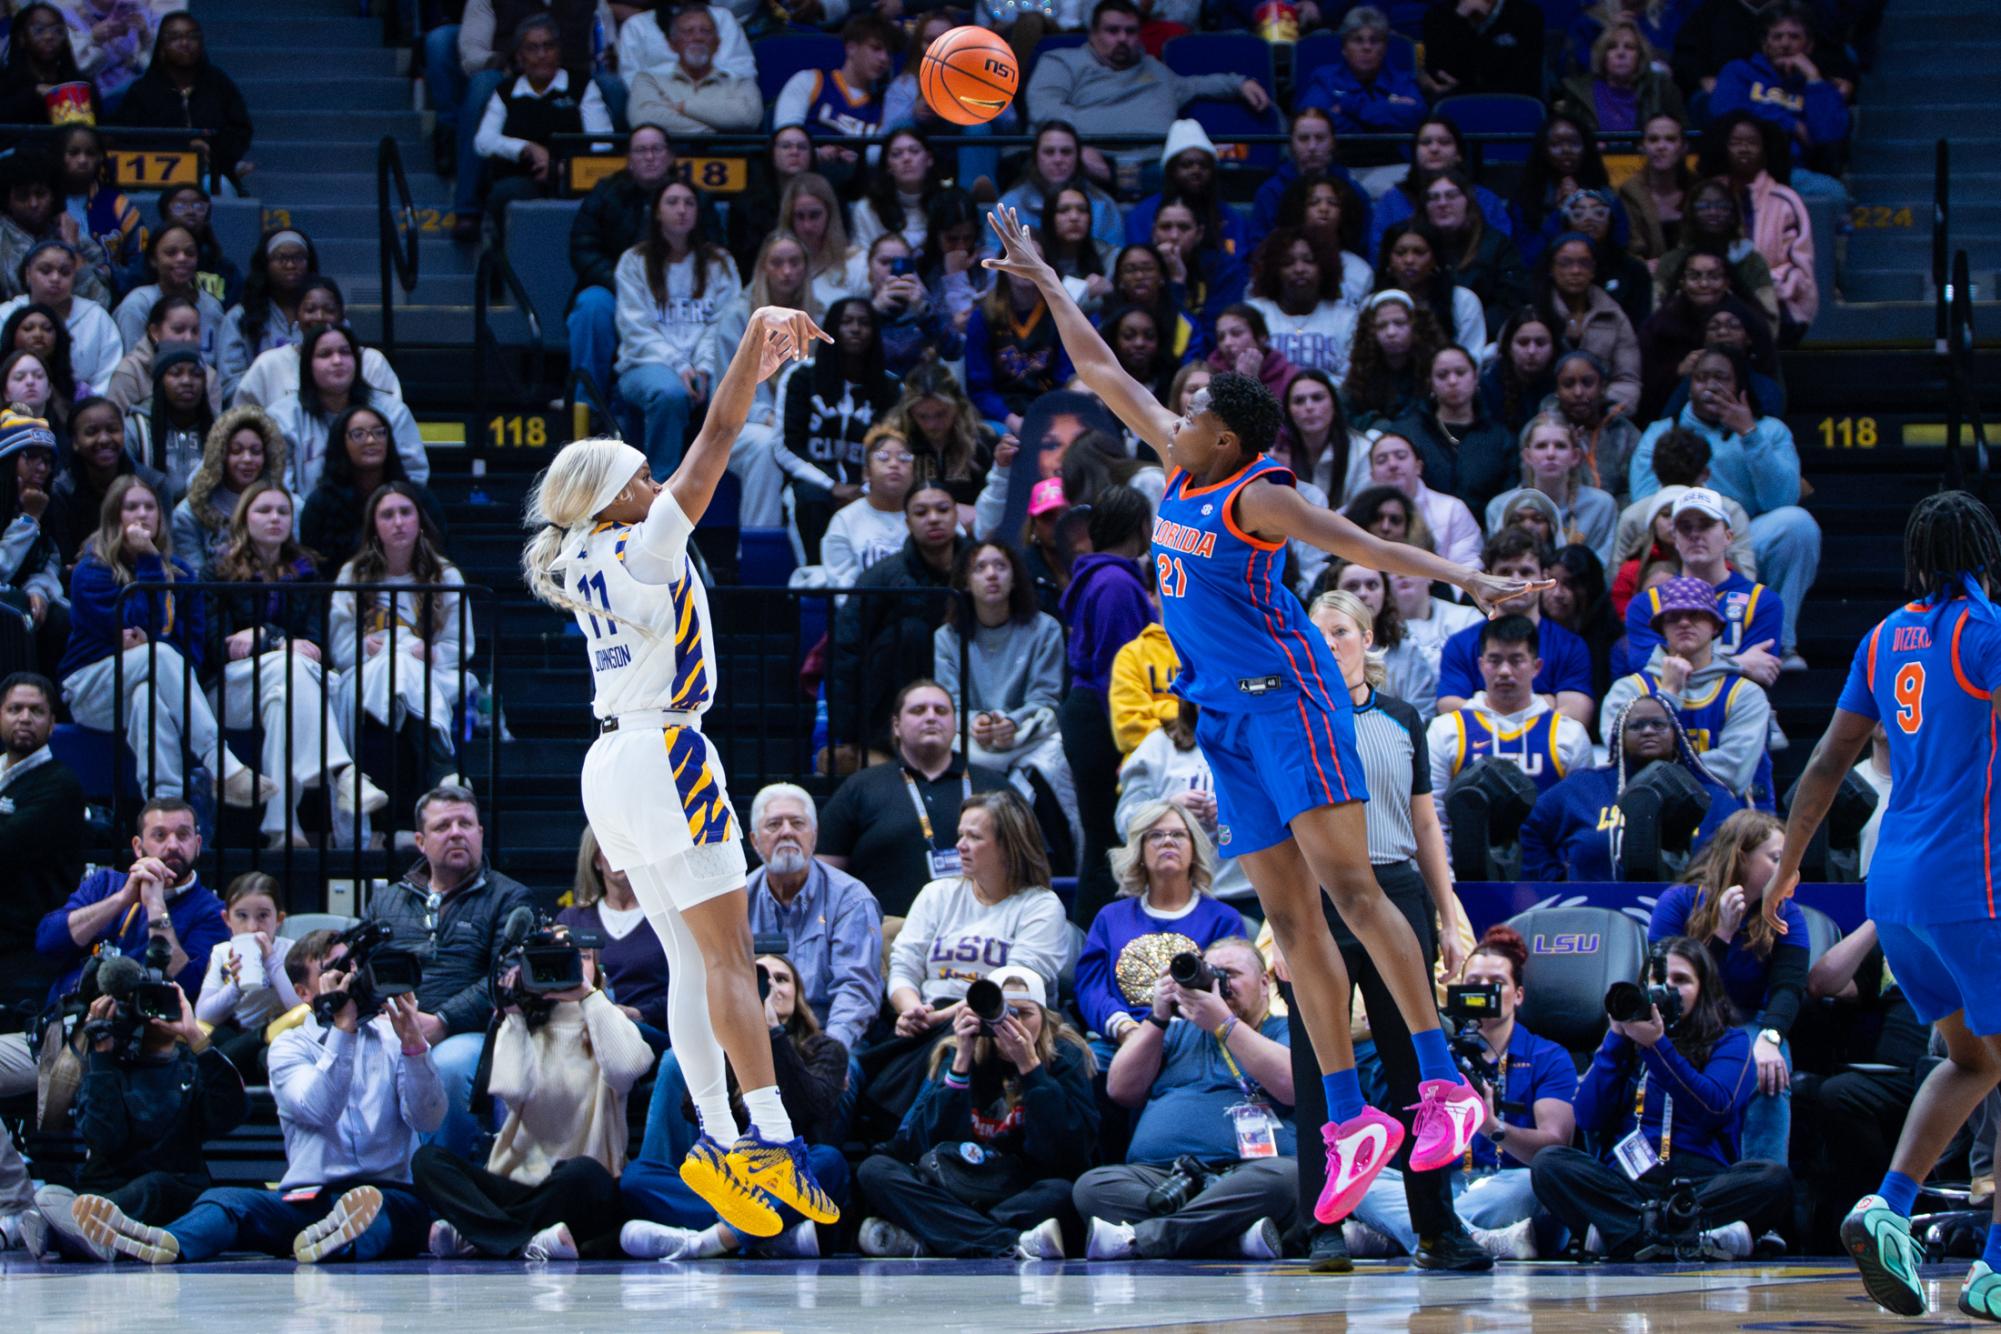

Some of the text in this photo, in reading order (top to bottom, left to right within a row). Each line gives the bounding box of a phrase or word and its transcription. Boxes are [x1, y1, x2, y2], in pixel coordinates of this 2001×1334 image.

[984, 59, 1016, 83] LSU
[489, 415, 547, 448] 118
[1817, 416, 1878, 449] 118
[1151, 515, 1218, 559] LORIDA
[1157, 553, 1187, 598] 21
[577, 569, 618, 640] 11
[594, 643, 632, 673] JOHNSON
[1894, 661, 1926, 735] 9
[929, 935, 1014, 968] LSU
[1533, 934, 1601, 954] LSU
